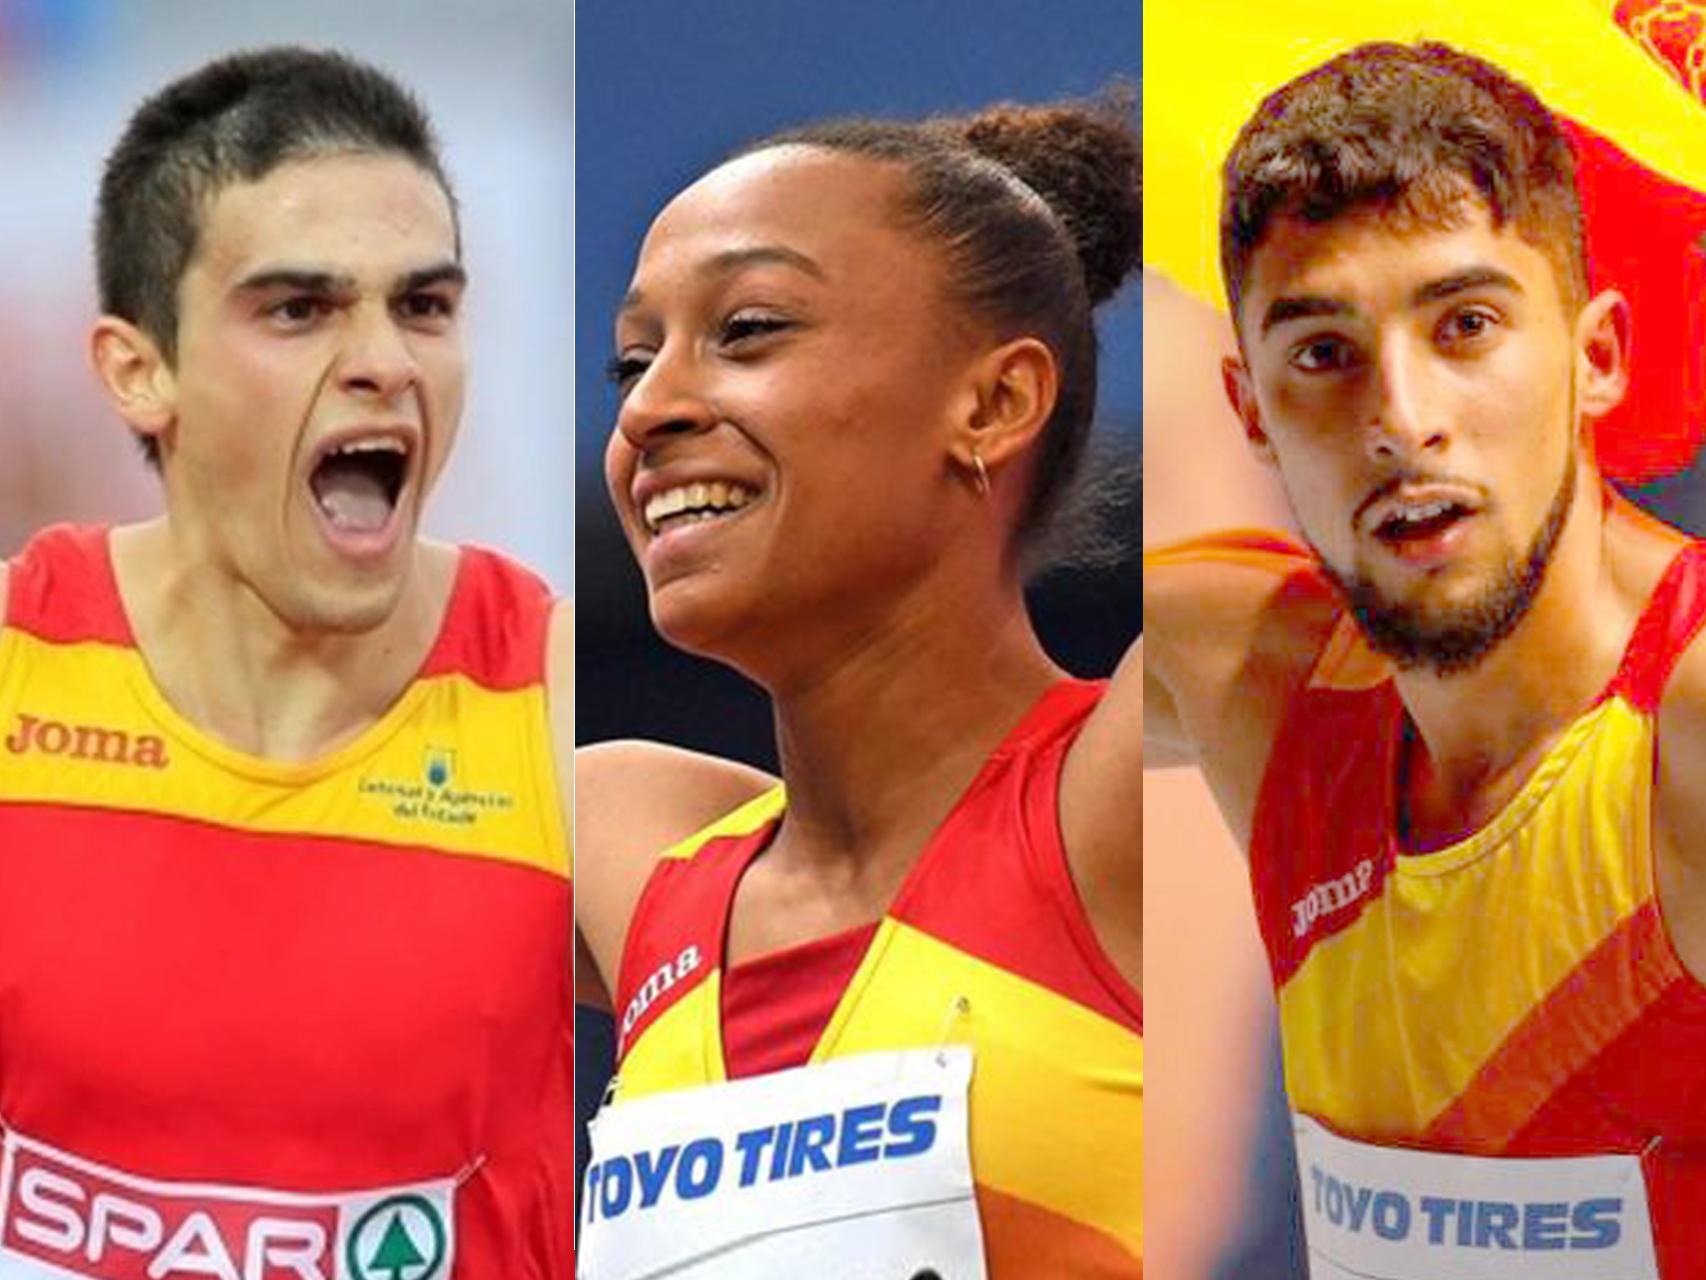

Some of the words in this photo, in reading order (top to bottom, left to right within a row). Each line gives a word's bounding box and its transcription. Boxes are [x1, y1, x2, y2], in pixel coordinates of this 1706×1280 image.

[624, 946, 702, 1034] oma
[735, 1095, 941, 1188] TIRES
[15, 1168, 327, 1280] SPAR
[1311, 1166, 1411, 1241] TOYO
[1420, 1198, 1623, 1251] TIRES
